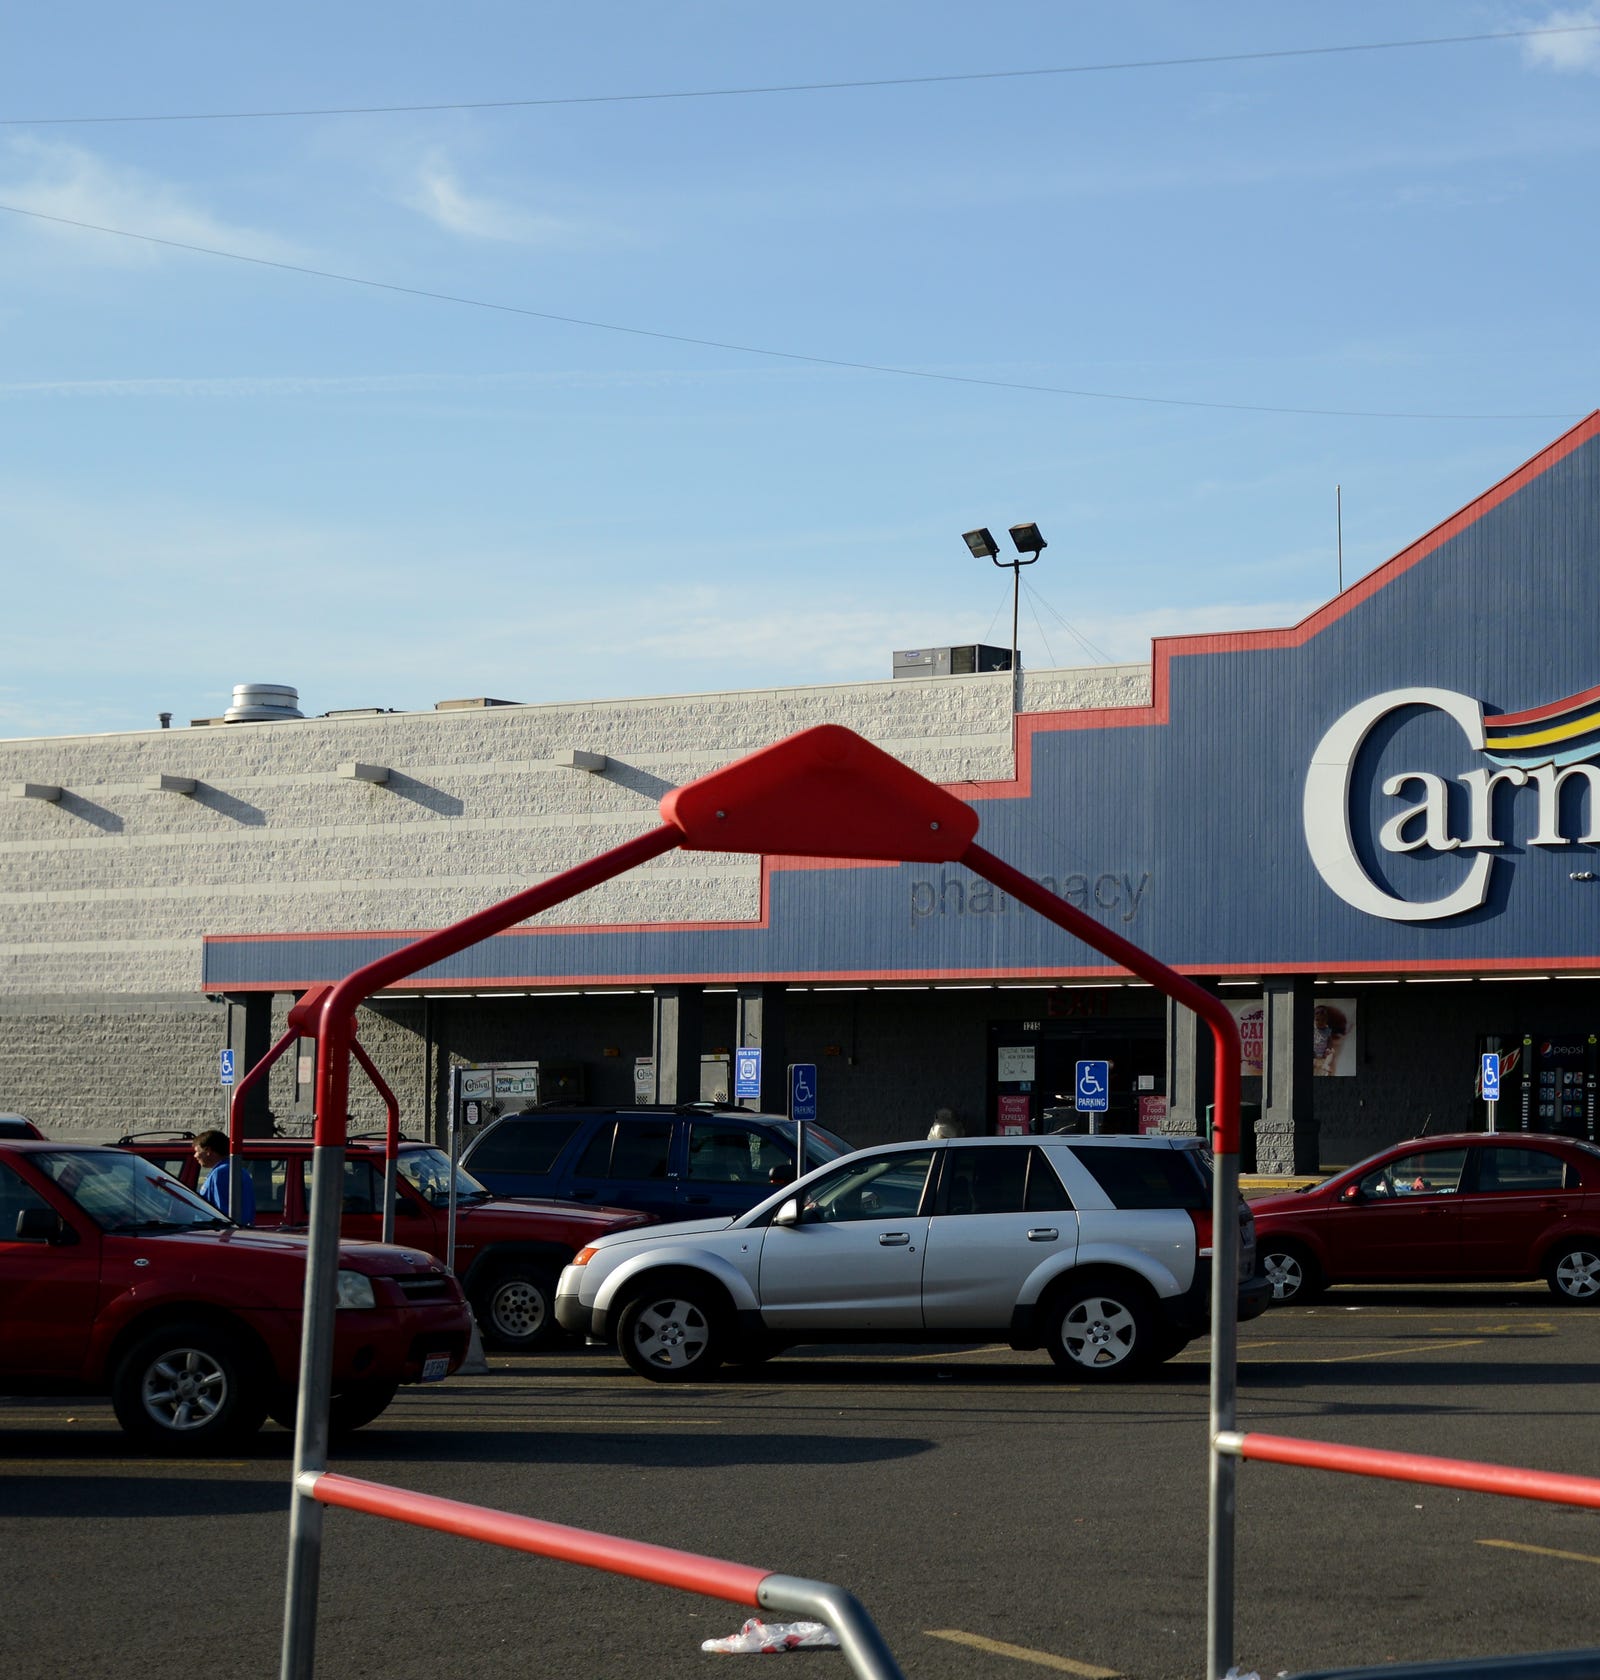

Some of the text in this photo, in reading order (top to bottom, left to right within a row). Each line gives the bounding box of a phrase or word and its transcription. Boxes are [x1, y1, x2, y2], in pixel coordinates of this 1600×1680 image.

[1047, 988, 1114, 1016] EXIT
[1241, 1022, 1263, 1039] CA
[1553, 1044, 1584, 1055] pepsi
[1078, 1098, 1106, 1107] PARKING
[795, 1105, 814, 1115] PARKING
